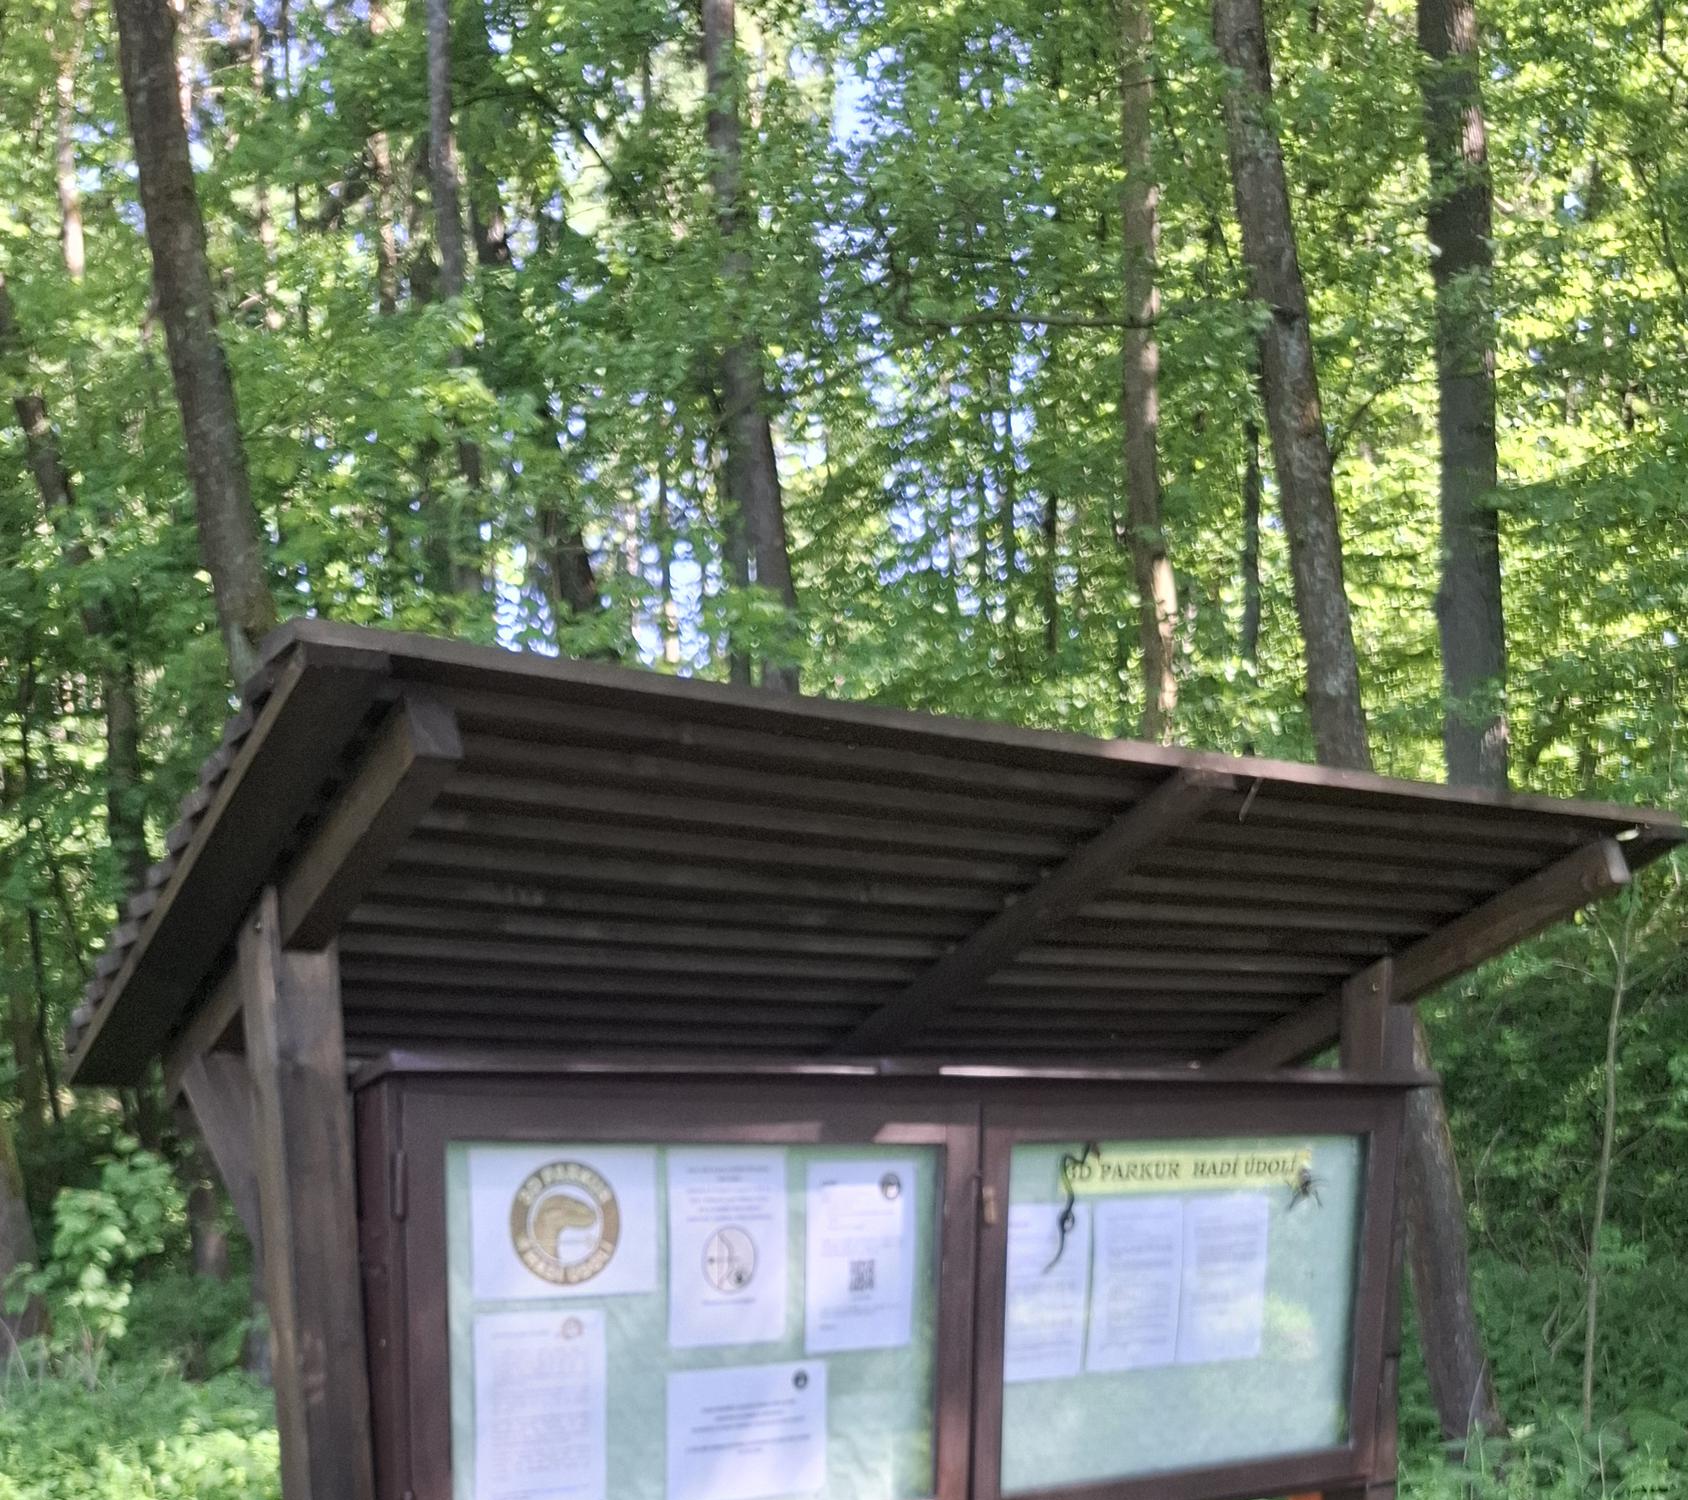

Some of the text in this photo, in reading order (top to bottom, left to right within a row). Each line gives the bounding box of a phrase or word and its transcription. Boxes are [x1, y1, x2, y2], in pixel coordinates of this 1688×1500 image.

[1101, 1162, 1181, 1182] PARKUR
[1192, 1152, 1239, 1178] HADÍ
[1243, 1151, 1297, 1176] ÚDOLÍ
